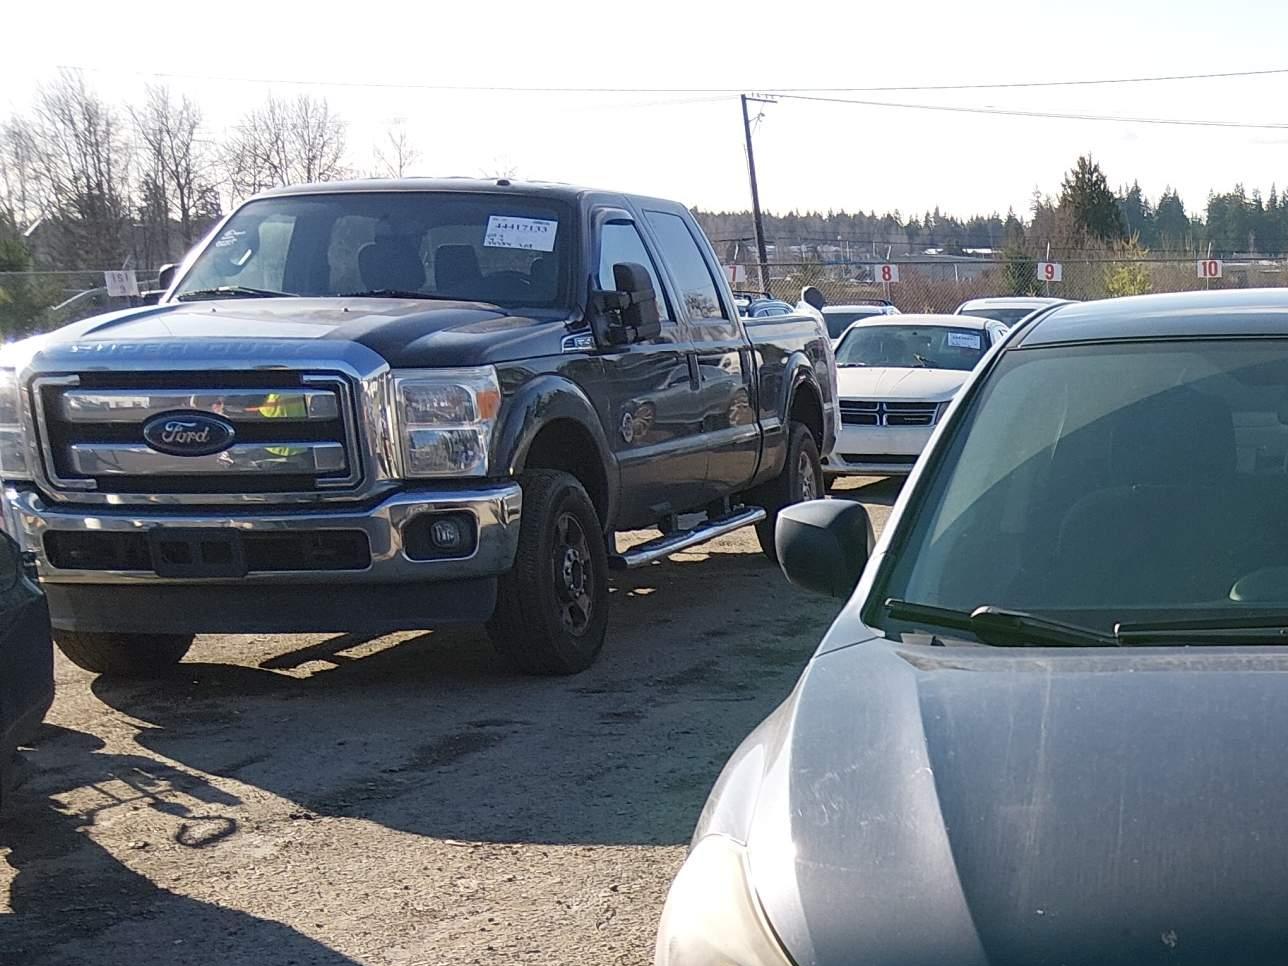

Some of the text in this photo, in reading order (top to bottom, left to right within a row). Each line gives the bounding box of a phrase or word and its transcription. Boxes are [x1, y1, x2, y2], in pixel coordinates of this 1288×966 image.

[728, 265, 737, 282] 7
[881, 265, 892, 282] 8
[1044, 263, 1055, 280] 9
[1201, 260, 1218, 277] 10
[161, 421, 211, 444] Ford
